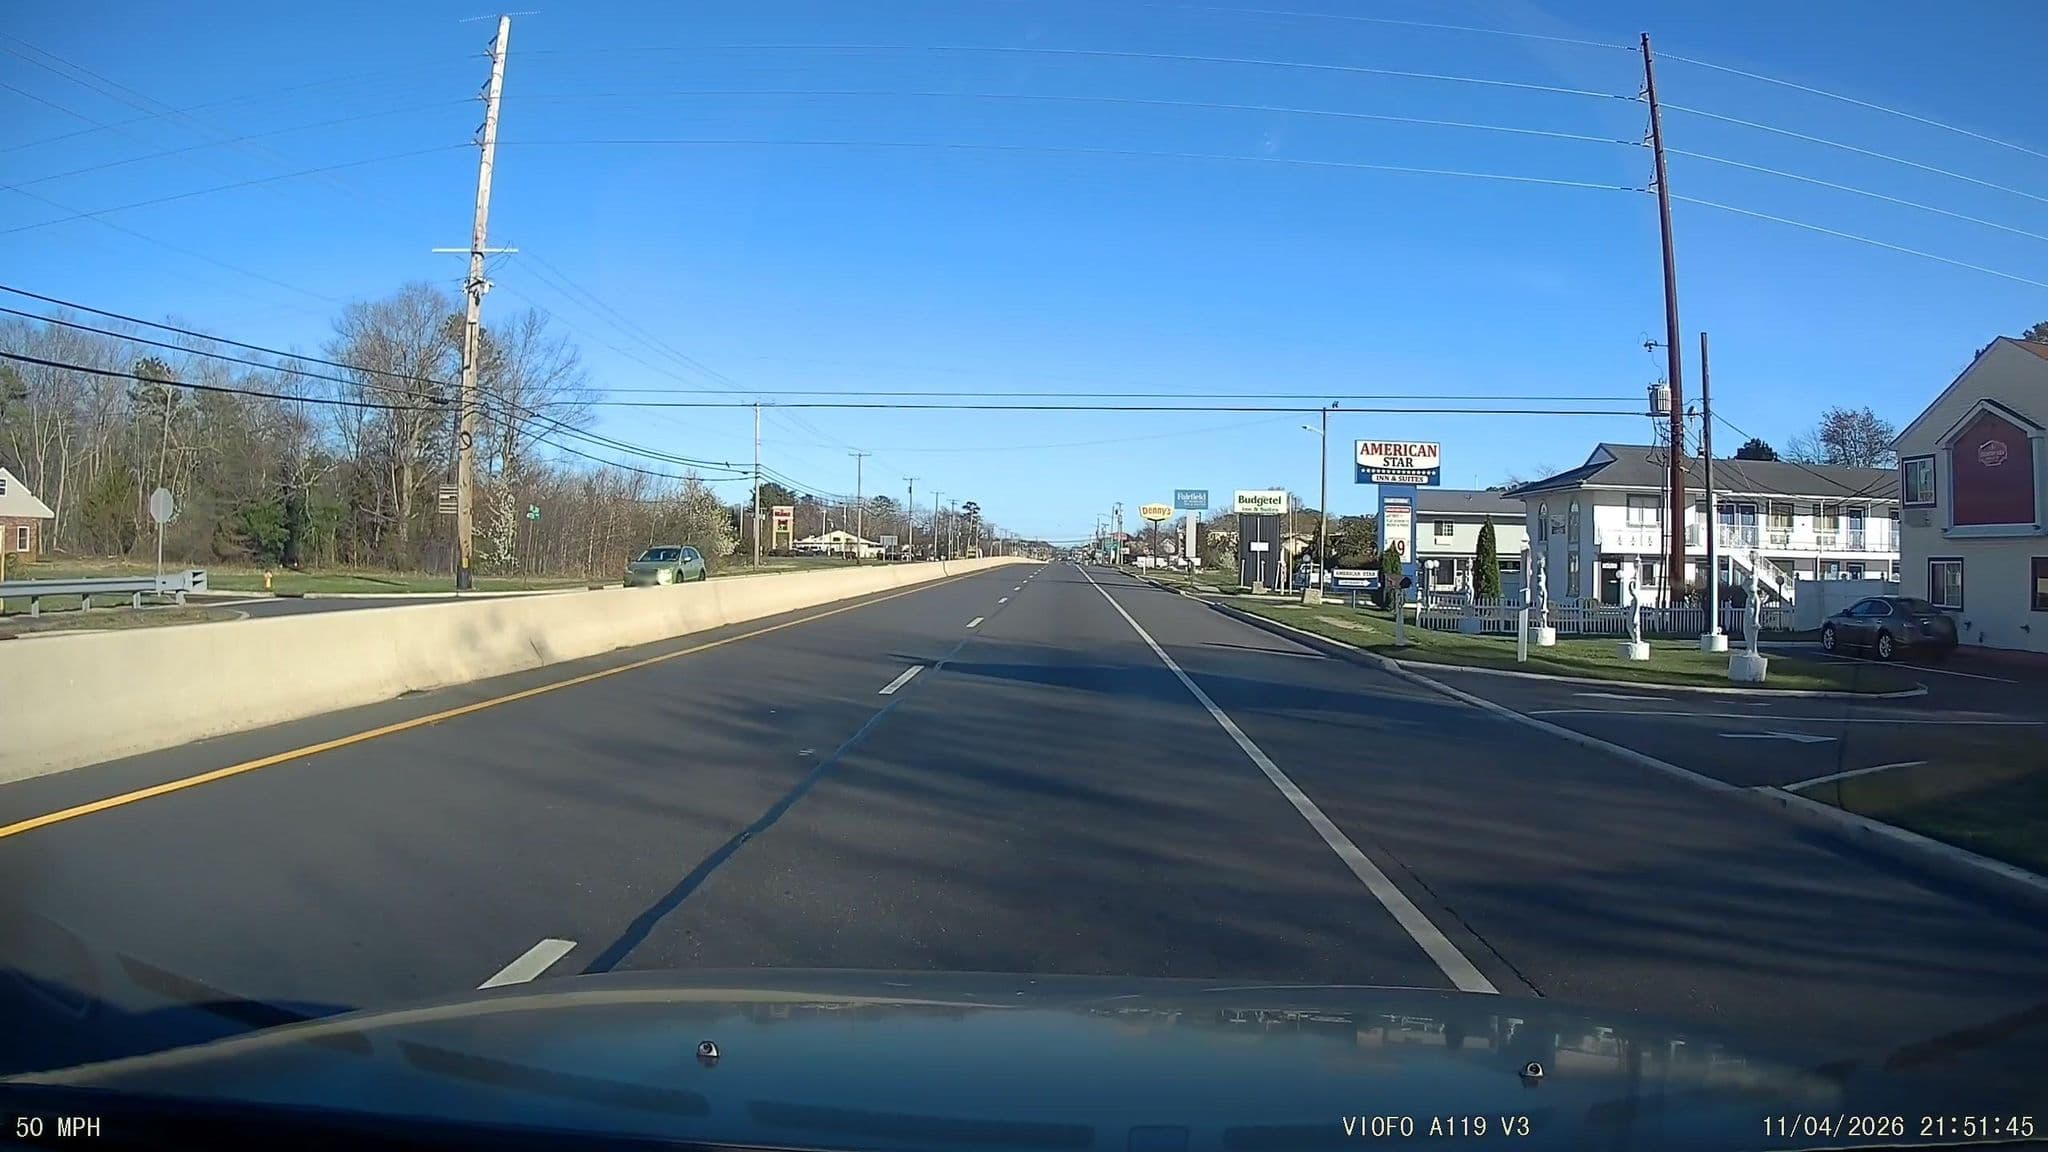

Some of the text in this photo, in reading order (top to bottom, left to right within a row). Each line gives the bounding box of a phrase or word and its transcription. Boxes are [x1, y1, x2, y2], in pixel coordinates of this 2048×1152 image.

[1360, 443, 1437, 458] AMERICAN
[1383, 457, 1413, 467] STAR
[1398, 475, 1424, 483] SUITES
[1238, 495, 1281, 507] Budgetel
[1142, 506, 1171, 516] Denny's
